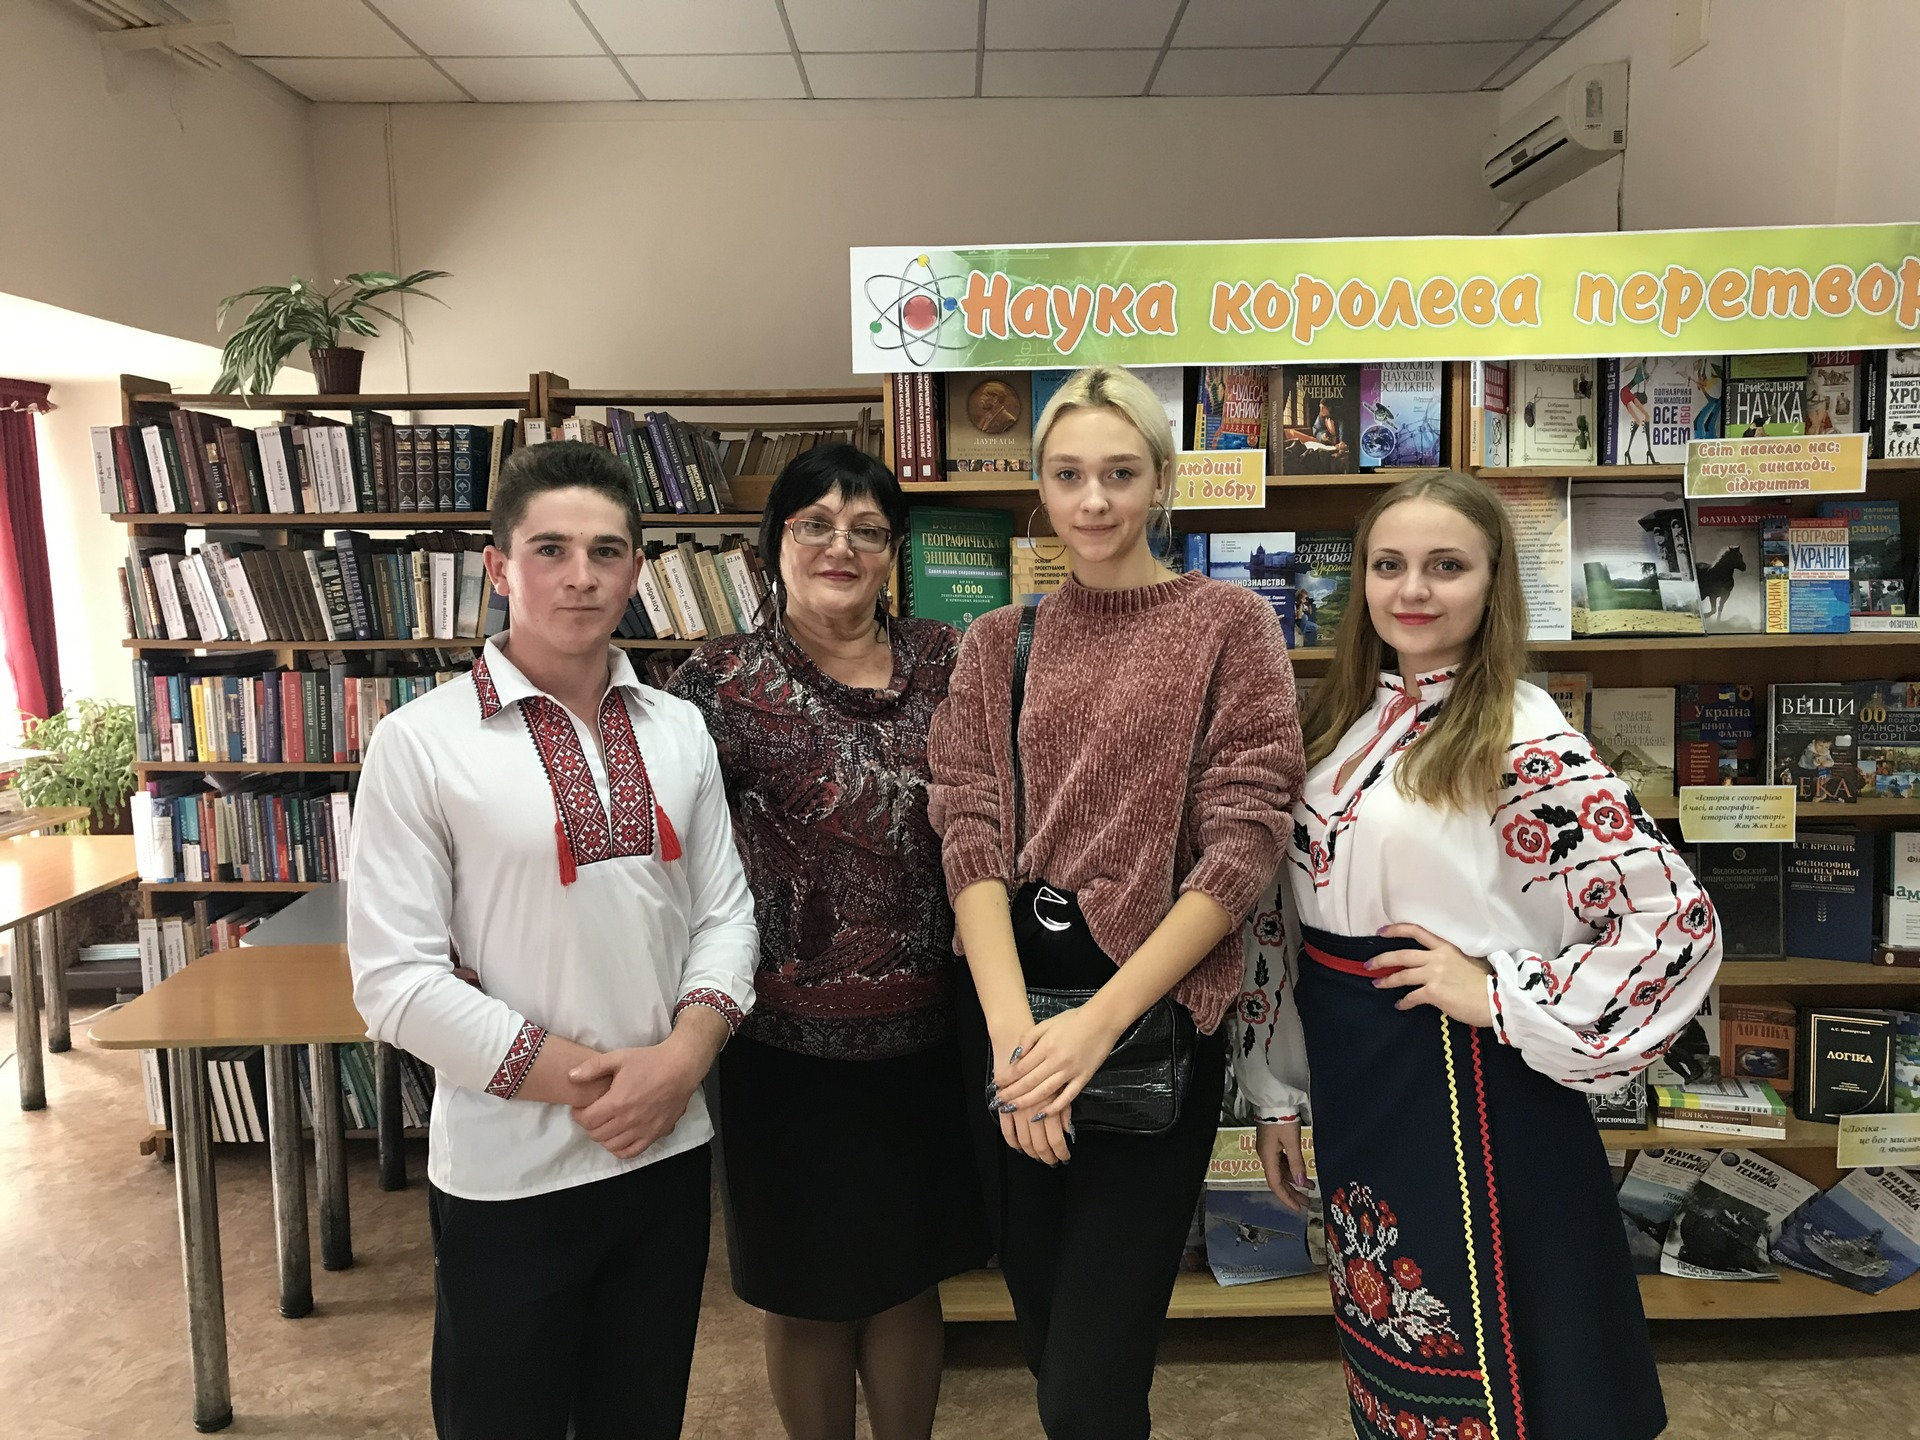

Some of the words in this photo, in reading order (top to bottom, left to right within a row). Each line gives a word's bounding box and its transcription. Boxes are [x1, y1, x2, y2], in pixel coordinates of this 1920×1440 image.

[961, 269, 1178, 355] Наука
[1209, 273, 1541, 345] королева
[1383, 371, 1434, 381] НАУКОВИХ
[1533, 361, 1589, 376] заблуждений
[1298, 375, 1346, 387] ВЕЛИКИХ
[1738, 382, 1804, 393] ПРИКОЛЬНАЯ
[1301, 387, 1344, 399] УЧЕНЫХ
[1225, 402, 1263, 418] ТЕХНИКИ
[1653, 405, 1679, 424] ВСЕ
[1736, 391, 1804, 424] НАУКА
[1792, 418, 1800, 433] 2
[1652, 427, 1691, 445] ВСЕМ
[1698, 443, 1734, 457] Світ
[1740, 441, 1801, 455] навколо
[1808, 441, 1840, 454] нас:
[643, 450, 661, 488] МАТЕМАТИКА
[1177, 458, 1242, 477] людині
[1701, 464, 1752, 478] наука,
[1758, 457, 1836, 474] винаходи,
[691, 463, 708, 500] ДИСКРЕТНА
[1726, 478, 1810, 493] відкриття
[655, 489, 667, 506] ВИЩА
[1202, 480, 1257, 501] добру
[1700, 515, 1738, 524] ФАУНА
[1790, 529, 1846, 543] ГЕОГРАФІЯ
[1297, 543, 1352, 553] ФІЗИЧНА
[923, 551, 1003, 568] ЭНЦИКЛОПЕД
[1295, 554, 1352, 564] ЕОГРАФІЯ
[1791, 544, 1846, 571] УКРАЇНИ
[951, 584, 963, 594] 10
[964, 584, 984, 595] 000
[1222, 578, 1286, 587] РАЇНОЗНАВСТВО
[643, 582, 661, 613] Алгебра
[1767, 581, 1782, 630] ДОВІДНИК
[439, 607, 449, 631] Історія
[1694, 704, 1751, 721] Україна
[1782, 697, 1855, 716] ВЕЩИ
[1860, 707, 1887, 723] 00
[1718, 730, 1752, 738] ФАКТІВ
[1858, 723, 1920, 732] РАЇНСЬКО
[1800, 776, 1853, 798] ЕКА
[1695, 793, 1730, 801] «Історія
[1736, 793, 1783, 802] географією
[1715, 804, 1754, 813] географія
[1701, 814, 1737, 822] історією
[1811, 843, 1856, 852] КРЕМЕНЬ
[1796, 860, 1850, 869] ФІЛОСОФІЯ
[1737, 1023, 1790, 1040] ЛОГИКА
[1826, 1050, 1873, 1064] ЛОГІКА
[1679, 1111, 1709, 1120] ЛОГІКА
[1859, 1137, 1870, 1145] це
[1871, 1135, 1887, 1144] бог
[1667, 1148, 1703, 1163] НАУКА
[1742, 1158, 1775, 1178] НАУКА
[1735, 1165, 1779, 1190] ТЕХНИКА
[1885, 1171, 1917, 1193] НАУКА
[1878, 1177, 1920, 1211] ТЕХНИКА
[1677, 1262, 1710, 1276] ПРОСТО
